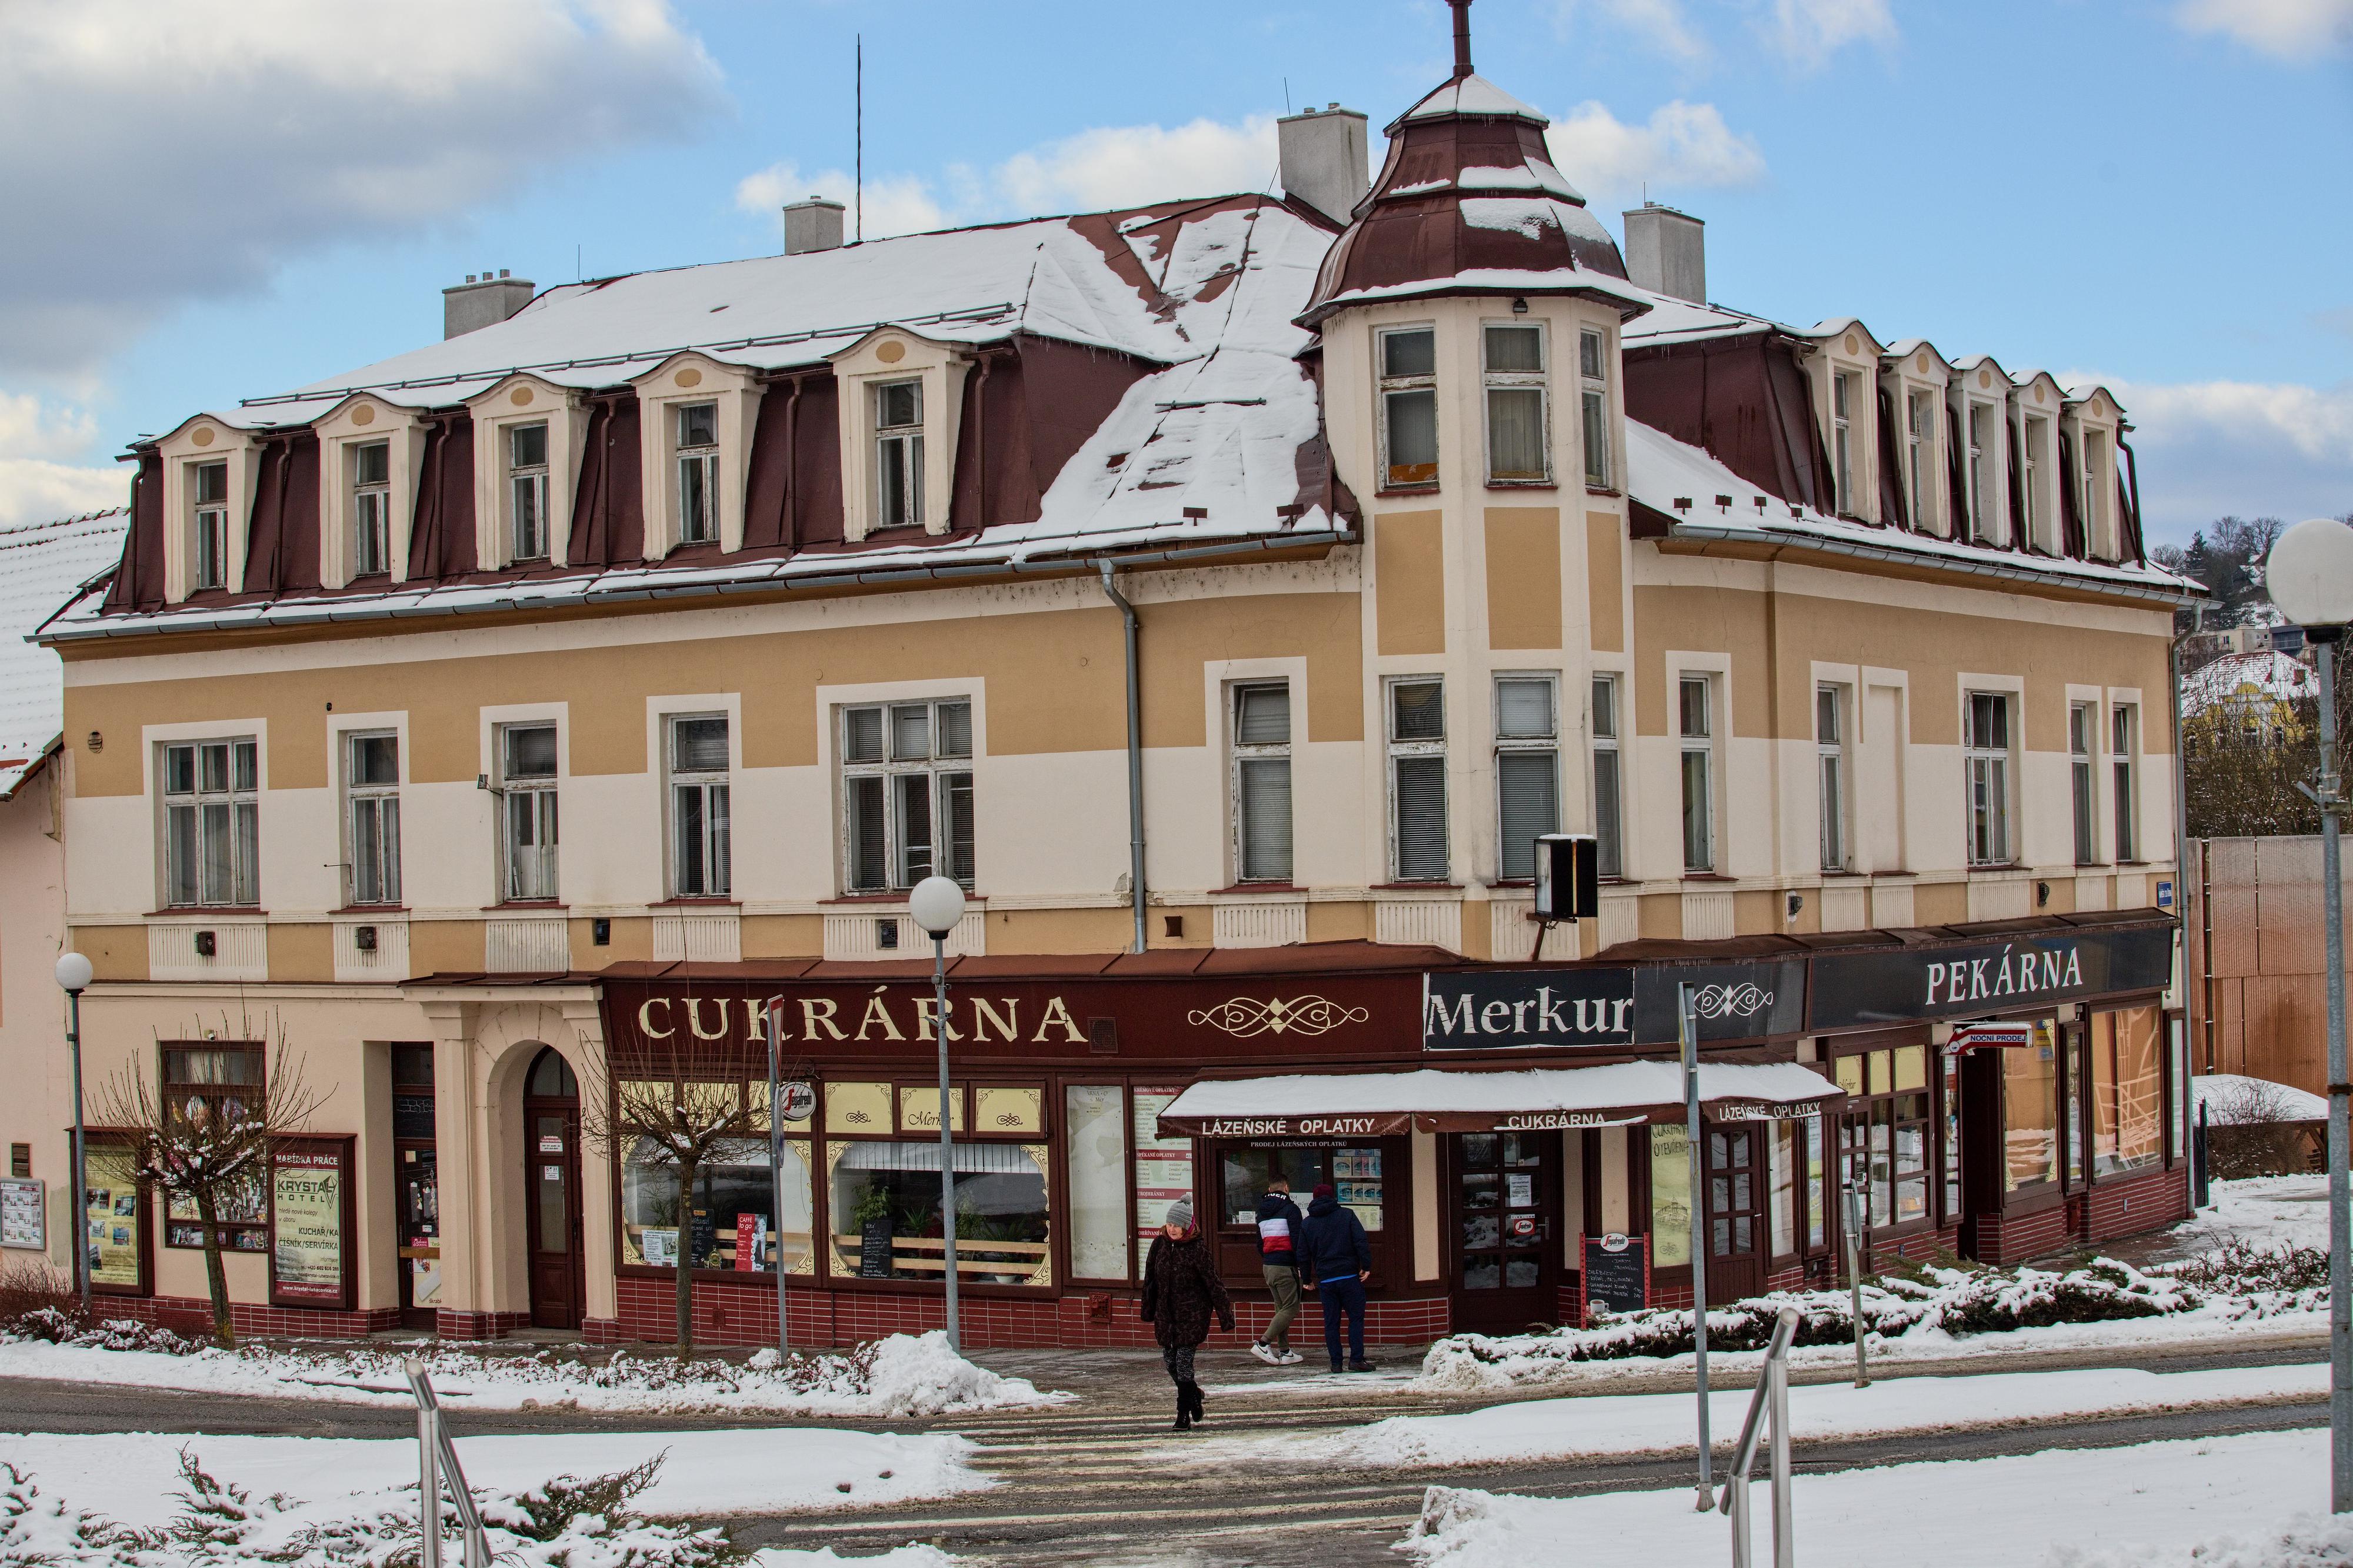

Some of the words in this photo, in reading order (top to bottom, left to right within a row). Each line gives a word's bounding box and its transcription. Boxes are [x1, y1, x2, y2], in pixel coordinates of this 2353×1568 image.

[1925, 943, 2083, 1005] PEKÁRNA
[638, 985, 1089, 1043] CUKRÁRNA
[1425, 986, 1634, 1037] Merkur
[784, 1089, 812, 1111] Segafredo
[1774, 1102, 1821, 1118] OPLATKY
[1202, 1117, 1287, 1135] LÁZEŇSKÉ
[1299, 1118, 1375, 1133] OPLATKY
[1508, 1111, 1605, 1129] CUKRÁRNA
[313, 1154, 338, 1165] PRÁCE
[277, 1180, 333, 1193] KRYSTAL
[278, 1194, 325, 1203] HOTEL
[299, 1226, 339, 1237] KUCHAŘ/KA
[278, 1237, 339, 1250] ČÍŠNÍK/SERVÍRKA
[1603, 1236, 1625, 1247] Segafredo
